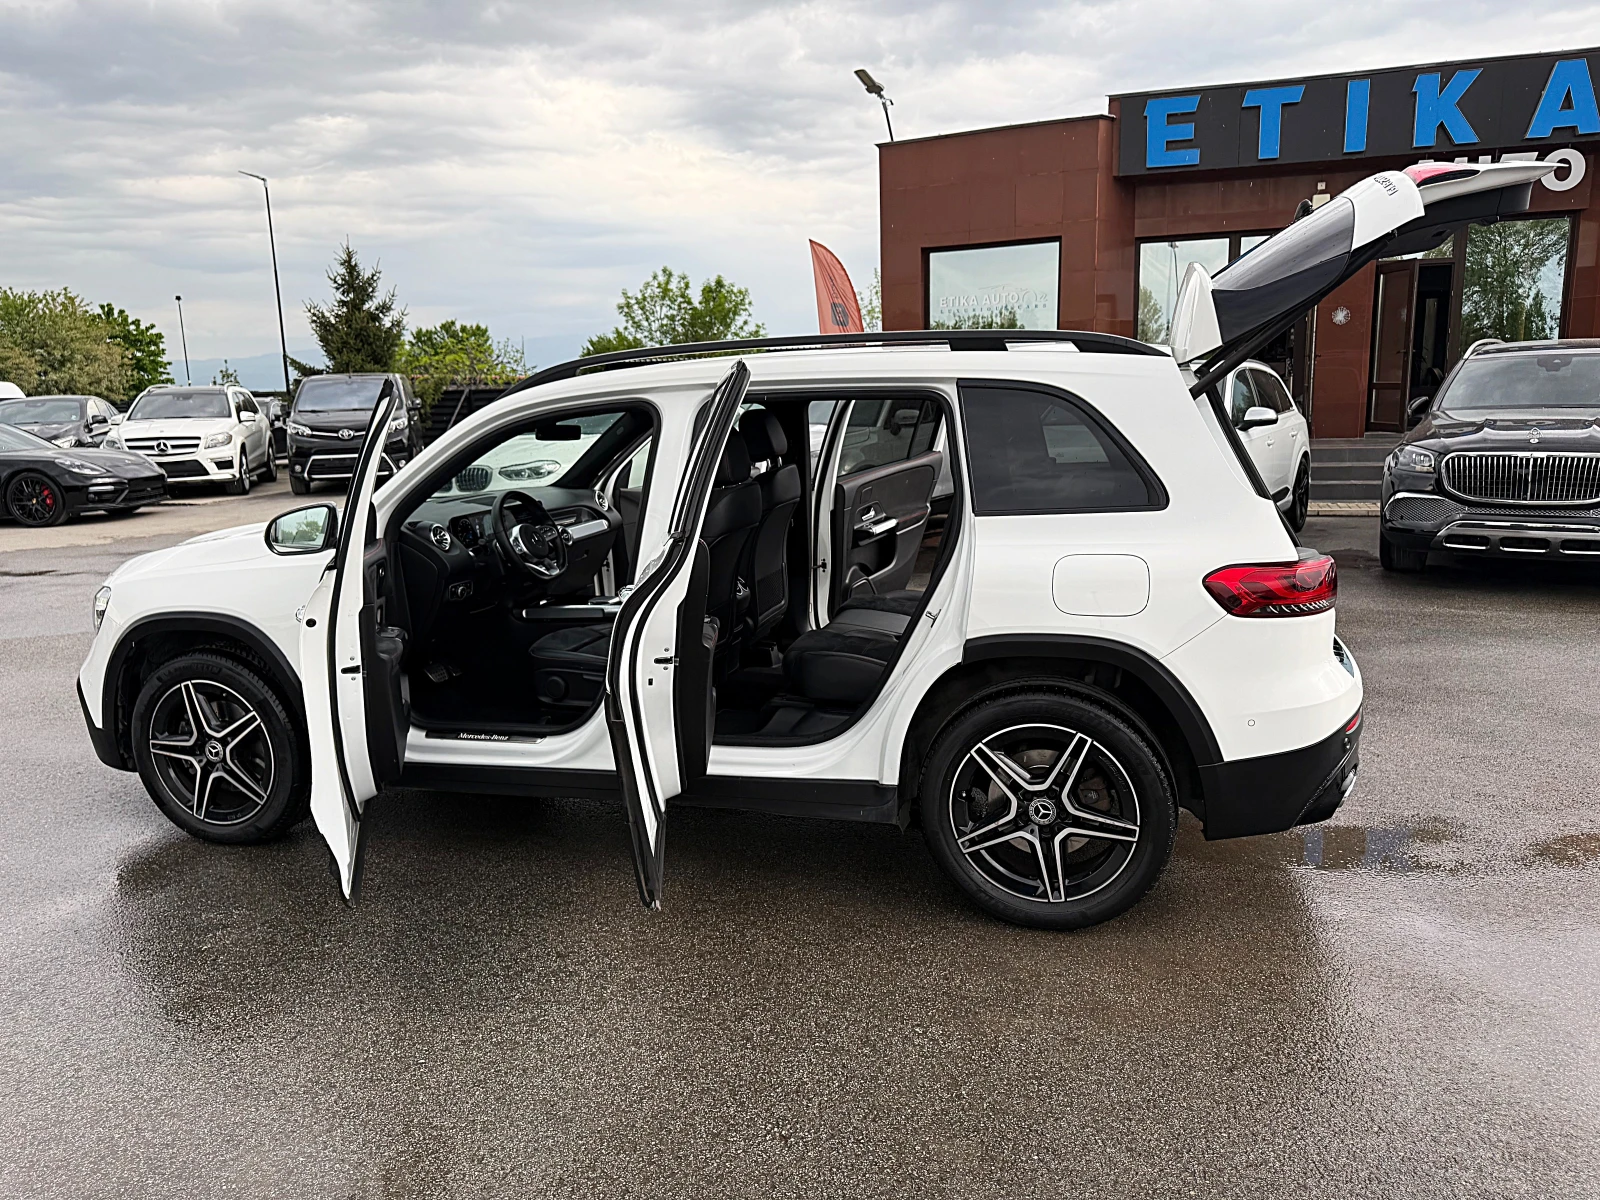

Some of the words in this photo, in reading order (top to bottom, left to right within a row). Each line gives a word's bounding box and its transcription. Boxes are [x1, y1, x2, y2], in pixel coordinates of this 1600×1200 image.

[1143, 58, 1600, 168] ETIKA
[940, 295, 978, 308] ETIKA
[981, 292, 1020, 305] AUTO
[457, 732, 509, 741] Mercedes-Benz
